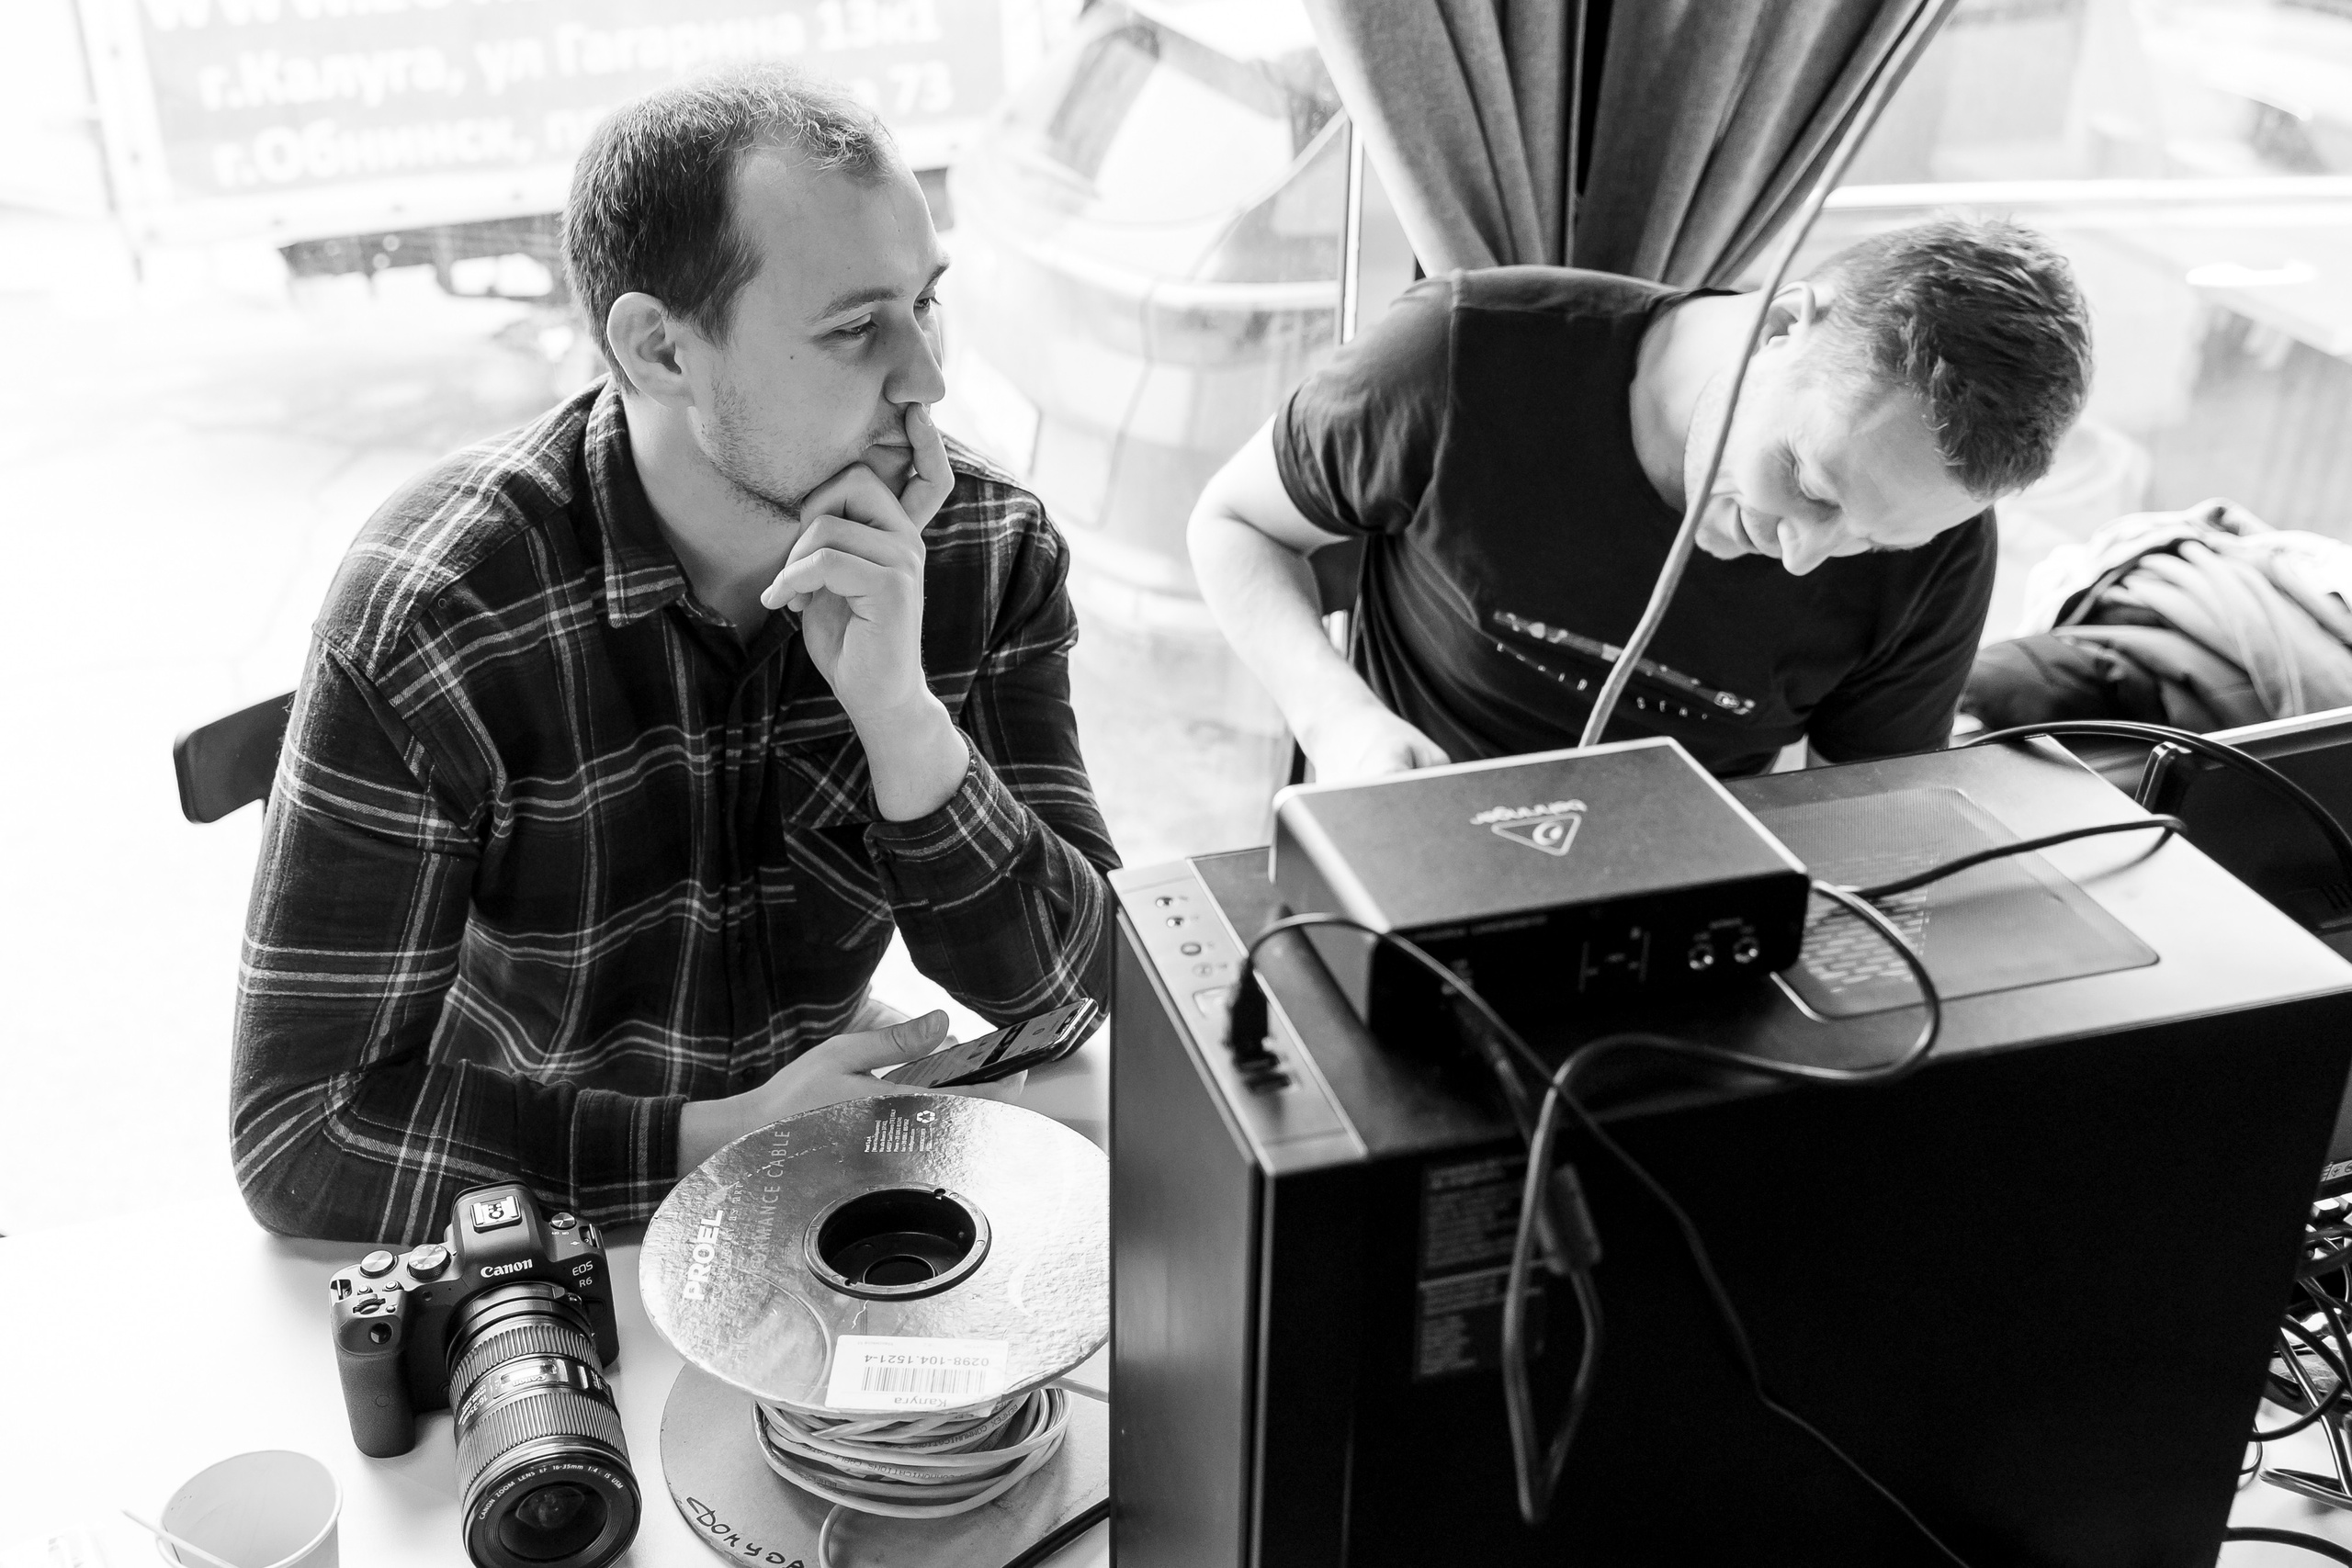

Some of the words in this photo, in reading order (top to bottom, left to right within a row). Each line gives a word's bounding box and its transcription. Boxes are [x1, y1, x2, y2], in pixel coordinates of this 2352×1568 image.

[474, 37, 548, 96] ул
[887, 59, 954, 116] 73
[766, 1129, 790, 1179] CABLE
[480, 1258, 533, 1279] Canon
[571, 1260, 594, 1277] EOS
[683, 1209, 724, 1301] PROEL
[579, 1276, 594, 1289] R6
[864, 1354, 989, 1368] 0298-104.1521-4
[894, 1394, 948, 1408] Калуга
[479, 1498, 496, 1520] CANON
[494, 1481, 515, 1497] ZOOM
[517, 1472, 536, 1483] LENS
[611, 1477, 625, 1489] USM
